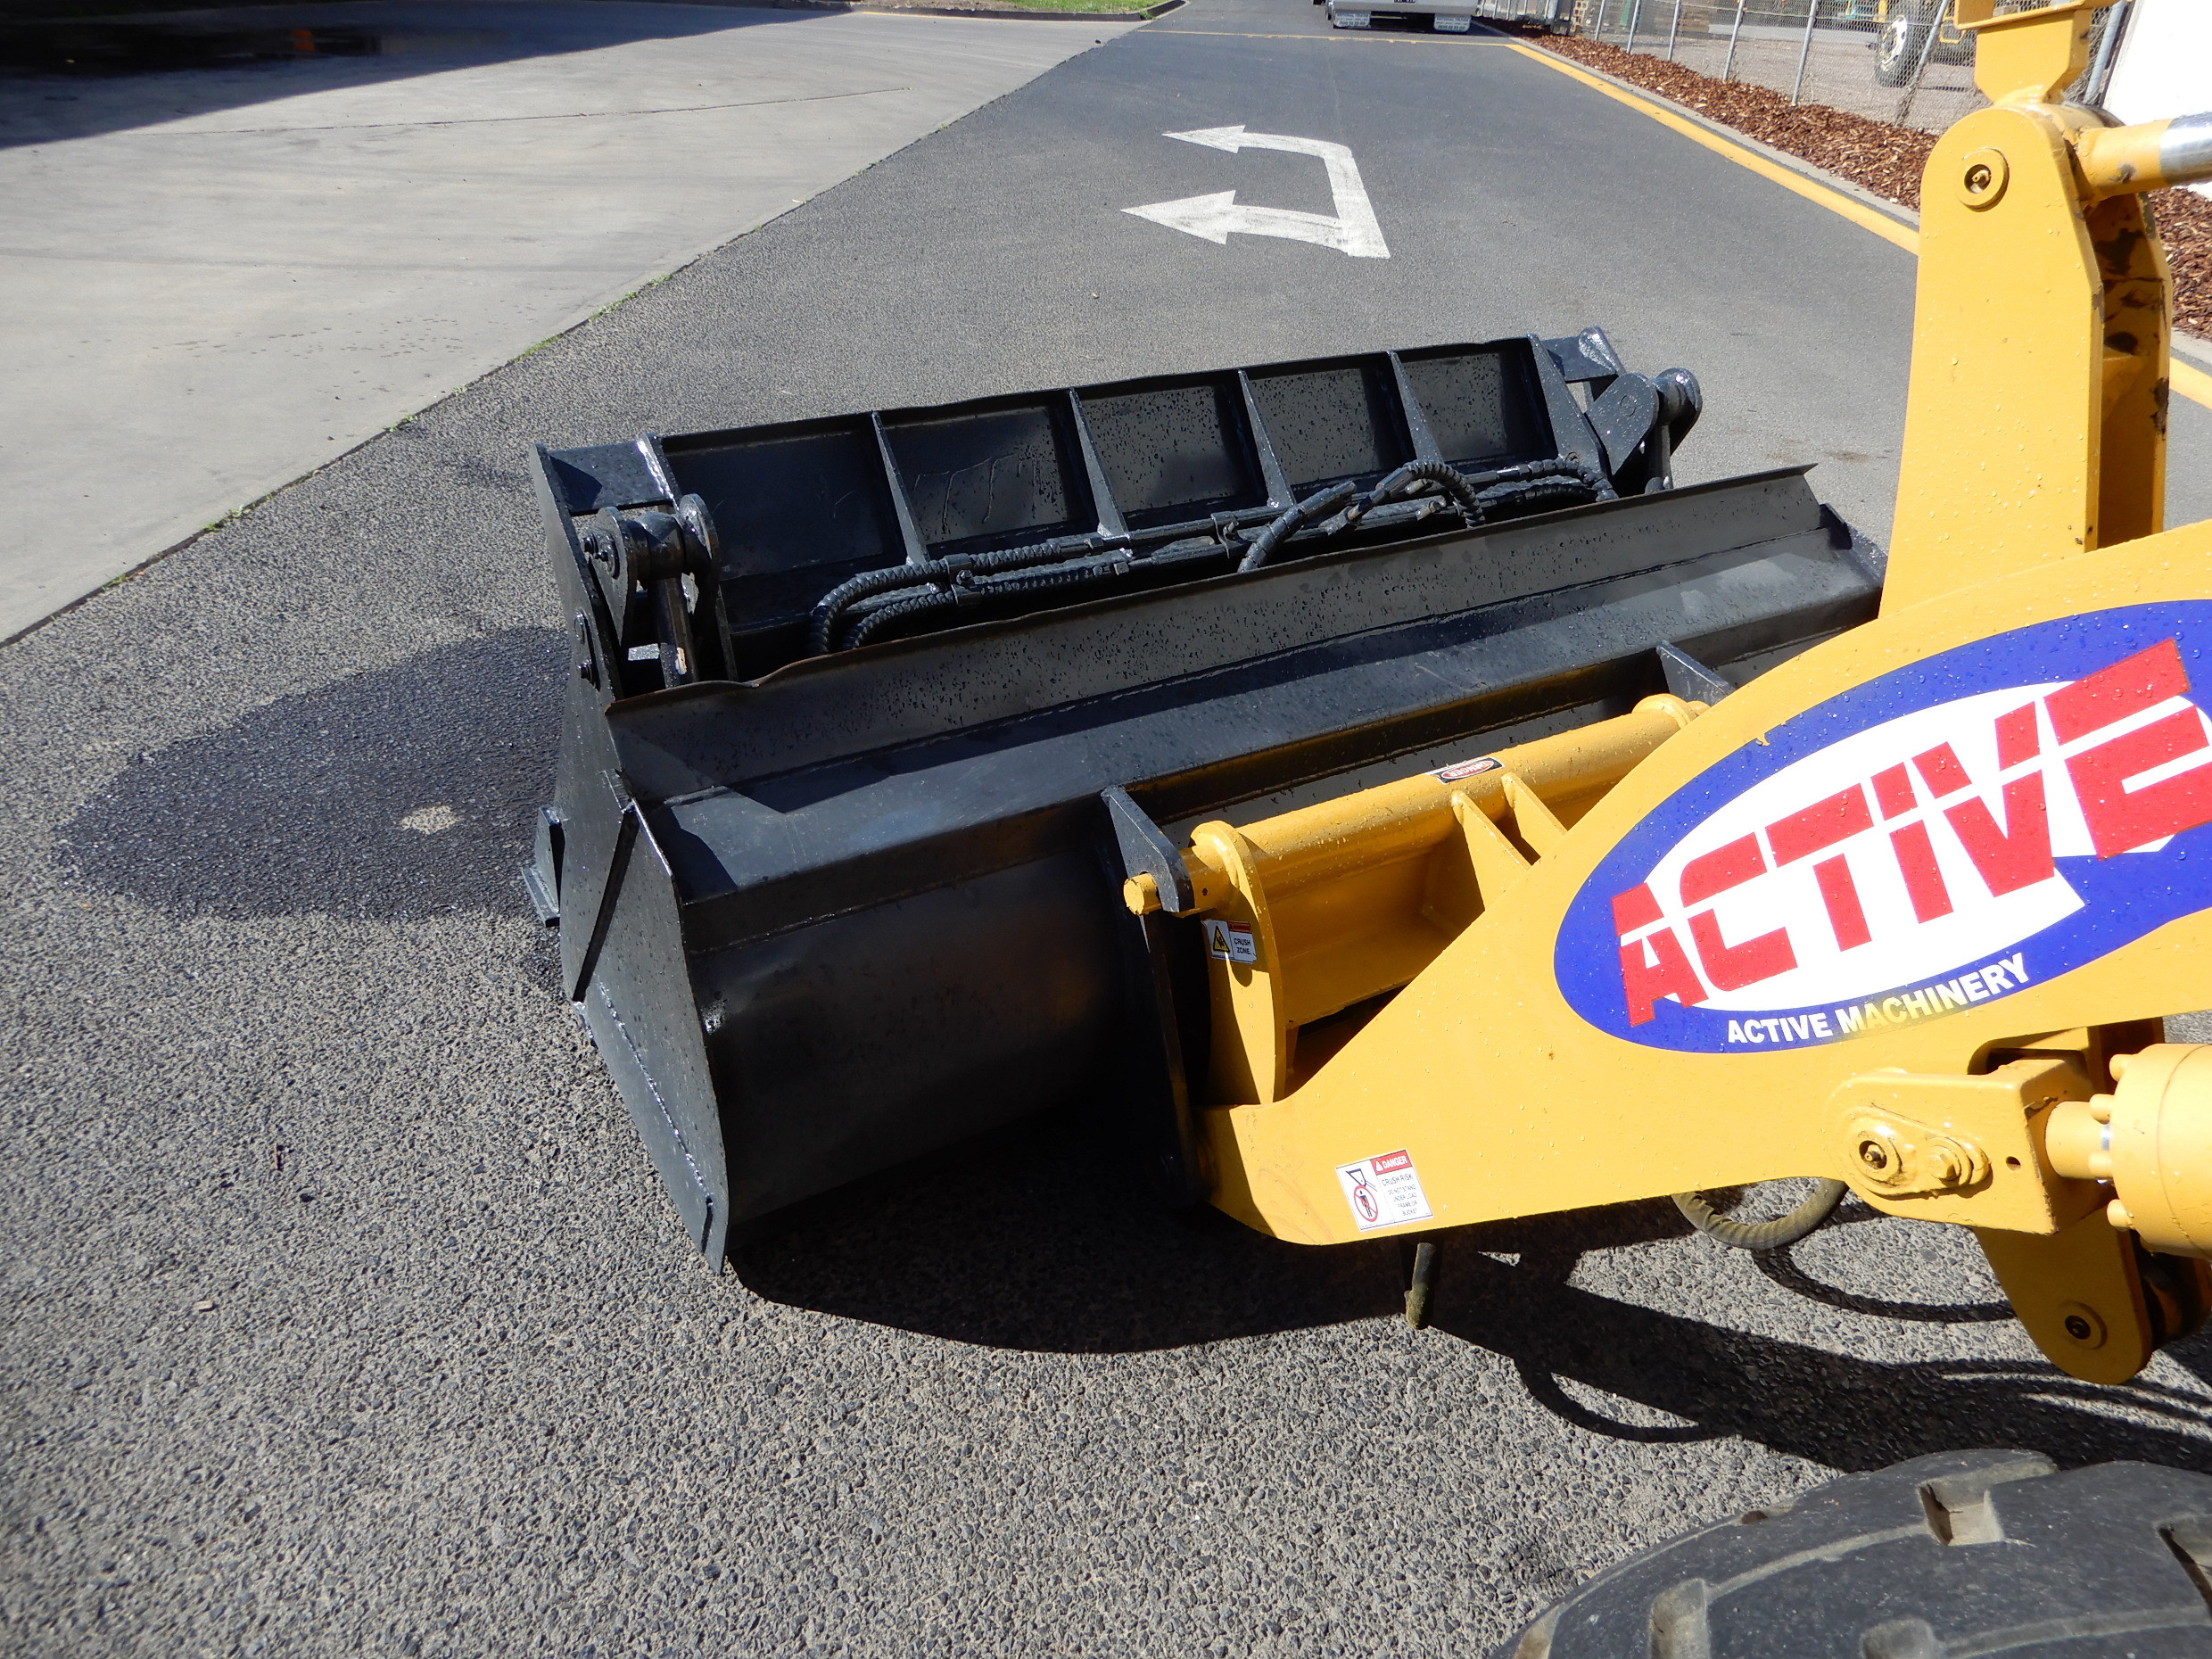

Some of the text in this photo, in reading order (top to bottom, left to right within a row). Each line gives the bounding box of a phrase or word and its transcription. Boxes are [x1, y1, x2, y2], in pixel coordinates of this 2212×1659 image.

[1611, 638, 2212, 1027] ACTIVE
[1234, 937, 1250, 946] CRUSH
[1236, 946, 1251, 955] ZONE
[1728, 952, 2029, 1044] ACTIVE MACHINERY
[1382, 1155, 1408, 1169] DANGER
[1382, 1173, 1415, 1186] CRUSH RISK
